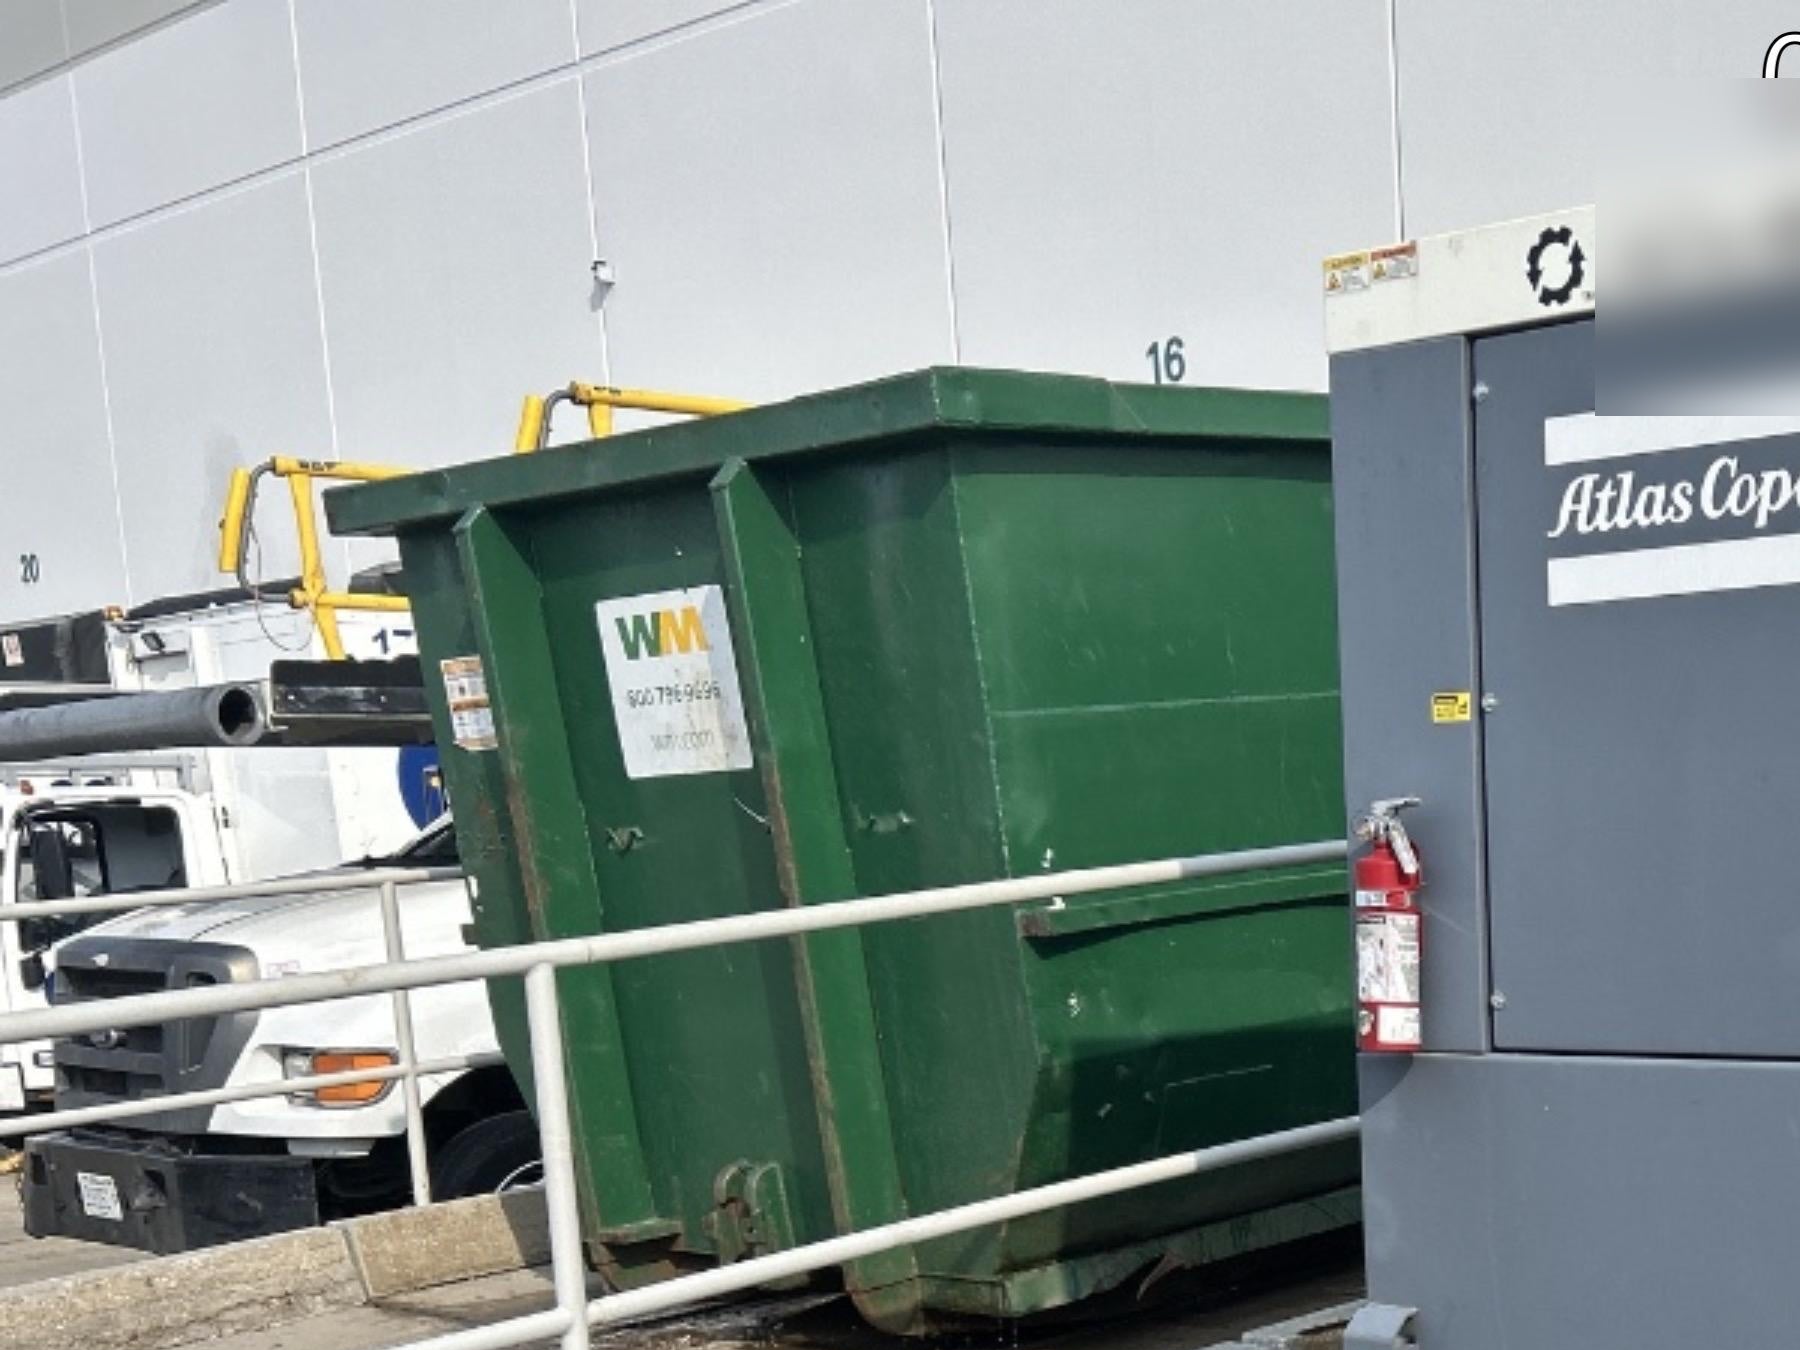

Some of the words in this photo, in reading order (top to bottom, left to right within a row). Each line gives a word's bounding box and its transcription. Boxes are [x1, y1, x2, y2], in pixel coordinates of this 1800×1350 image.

[1145, 335, 1186, 385] 16
[1547, 471, 1695, 538] Atlas
[20, 553, 40, 583] 20
[615, 605, 710, 660] WM
